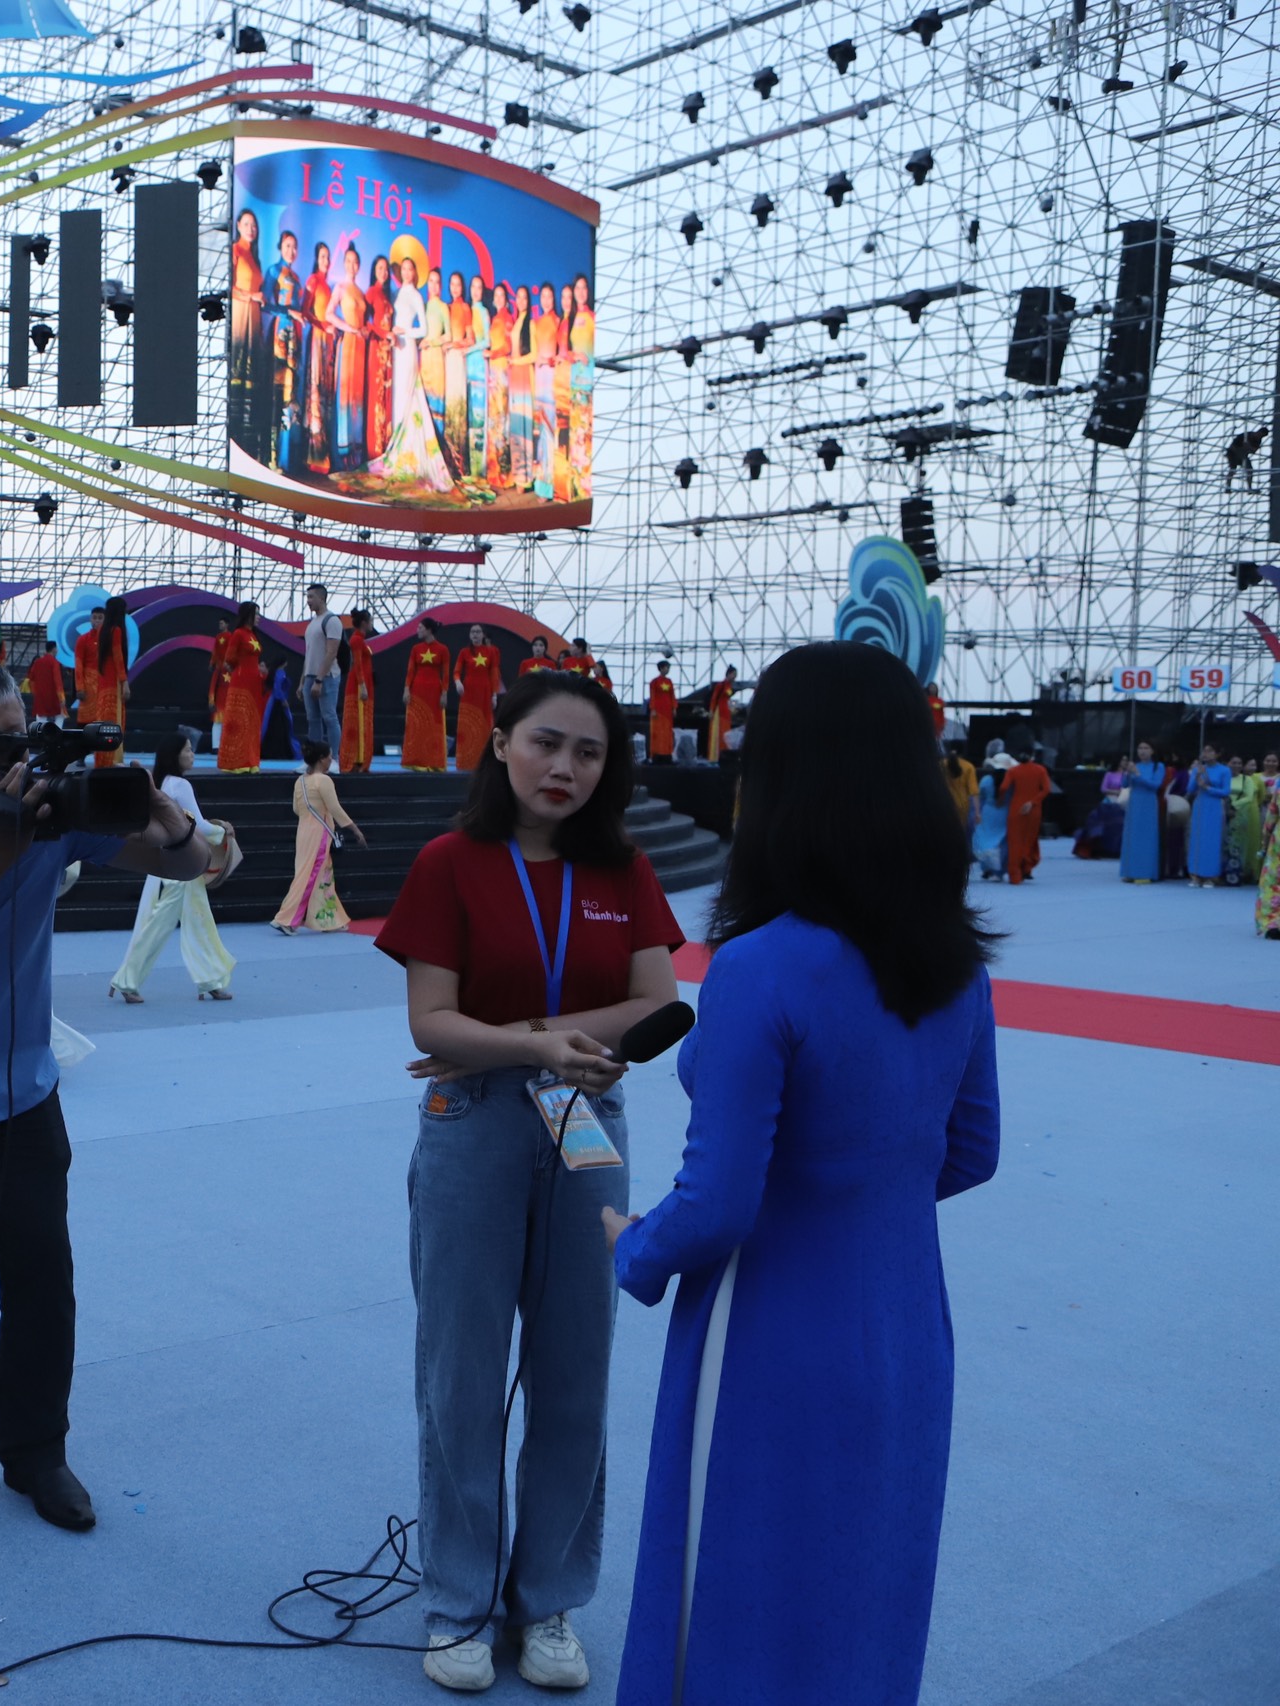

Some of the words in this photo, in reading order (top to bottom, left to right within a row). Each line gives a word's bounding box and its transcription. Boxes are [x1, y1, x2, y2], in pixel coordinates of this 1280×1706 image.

[300, 159, 345, 210] Lễ
[355, 175, 414, 231] Hội
[1120, 670, 1152, 690] 60
[1189, 668, 1225, 690] 59
